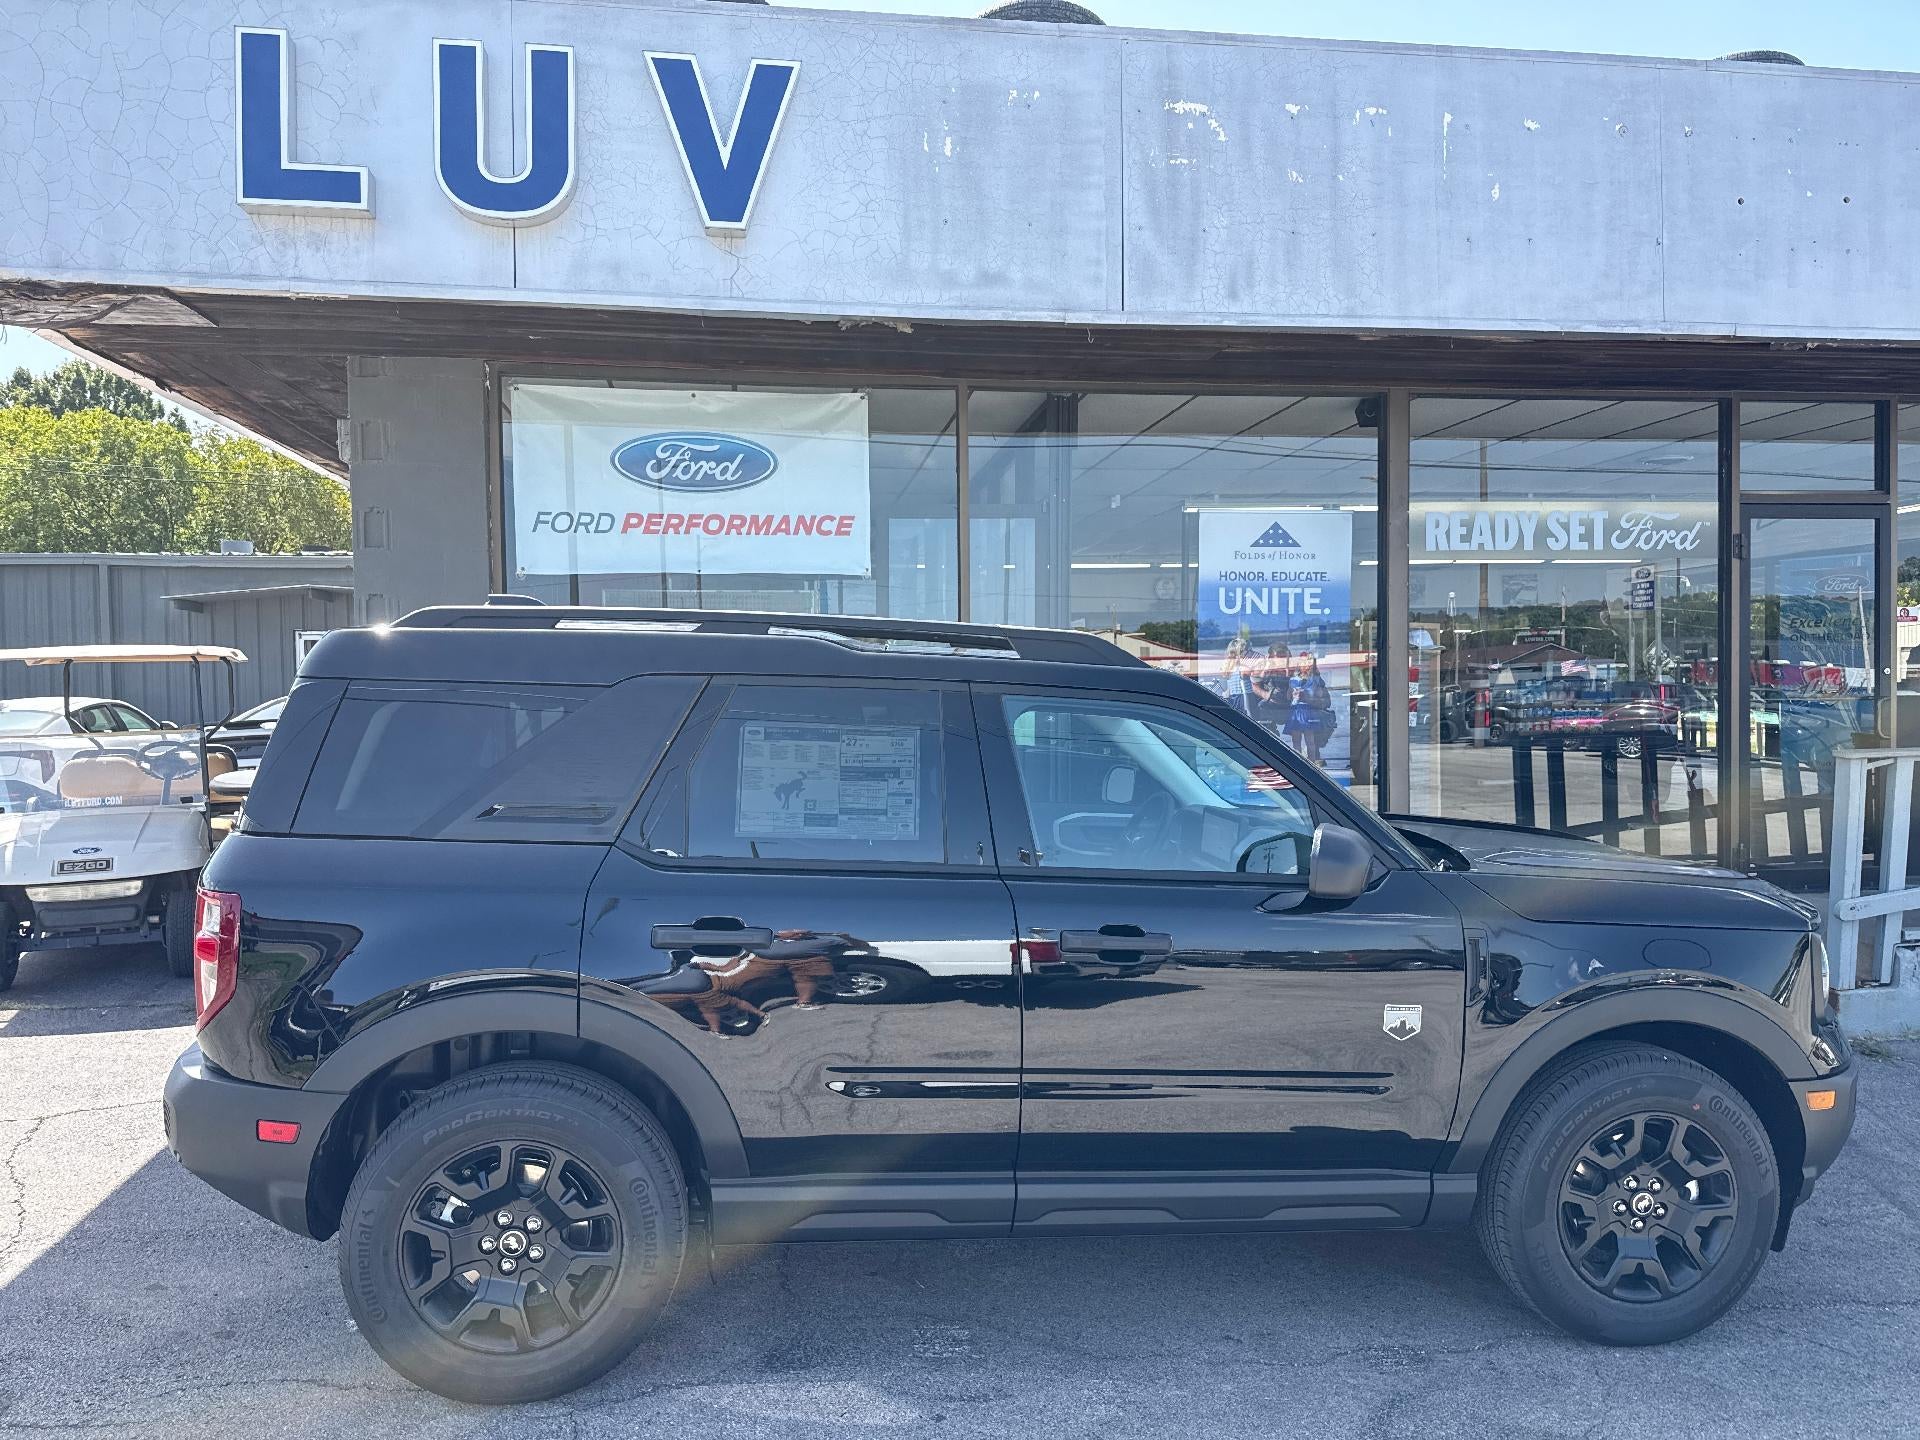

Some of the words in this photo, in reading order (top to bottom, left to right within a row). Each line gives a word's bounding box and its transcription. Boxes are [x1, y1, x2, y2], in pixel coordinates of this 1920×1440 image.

[234, 26, 802, 237] LUV
[645, 441, 745, 482] Ford
[532, 511, 616, 534] FORD
[620, 512, 856, 537] PERFORMANCE
[1425, 511, 1541, 551] READY
[1546, 511, 1609, 551] SET
[1610, 510, 1703, 551] Ford
[1219, 571, 1268, 582] HONOR.
[1271, 571, 1331, 582] EDUCATE.
[1824, 577, 1859, 591] Ford
[1218, 587, 1331, 615] UNITE.
